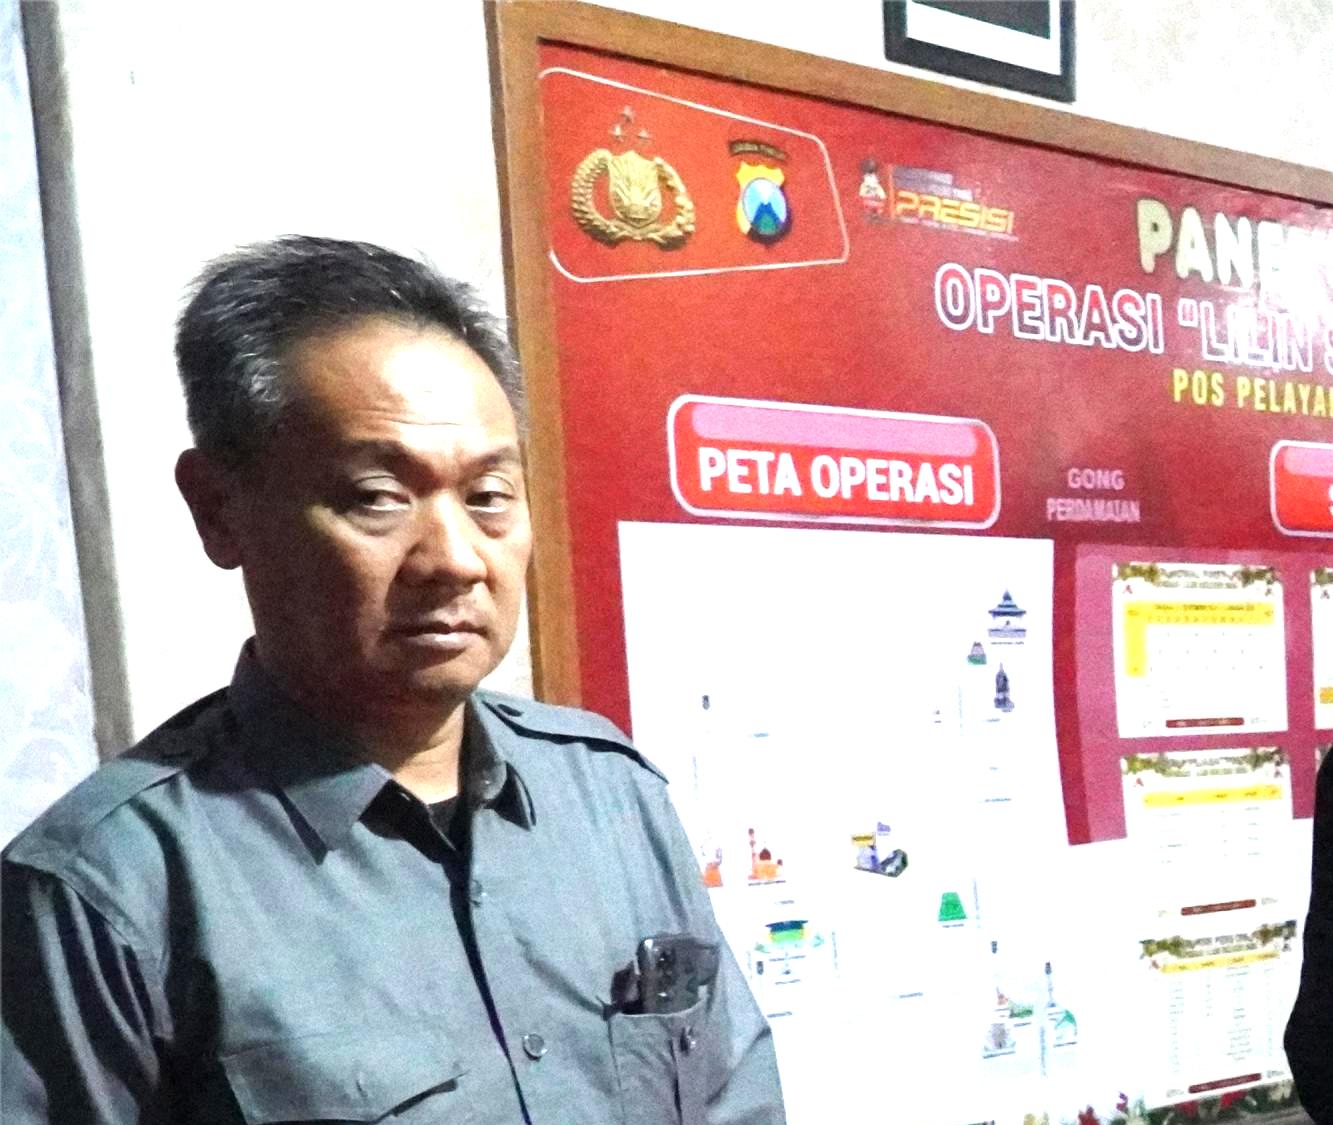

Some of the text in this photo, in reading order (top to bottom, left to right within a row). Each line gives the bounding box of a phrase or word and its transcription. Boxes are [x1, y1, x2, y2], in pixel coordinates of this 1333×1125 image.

[935, 263, 1164, 355] OPERASI
[1173, 368, 1224, 406] POS
[700, 447, 974, 506] PETA OPERASI
[1067, 467, 1126, 491] GONG
